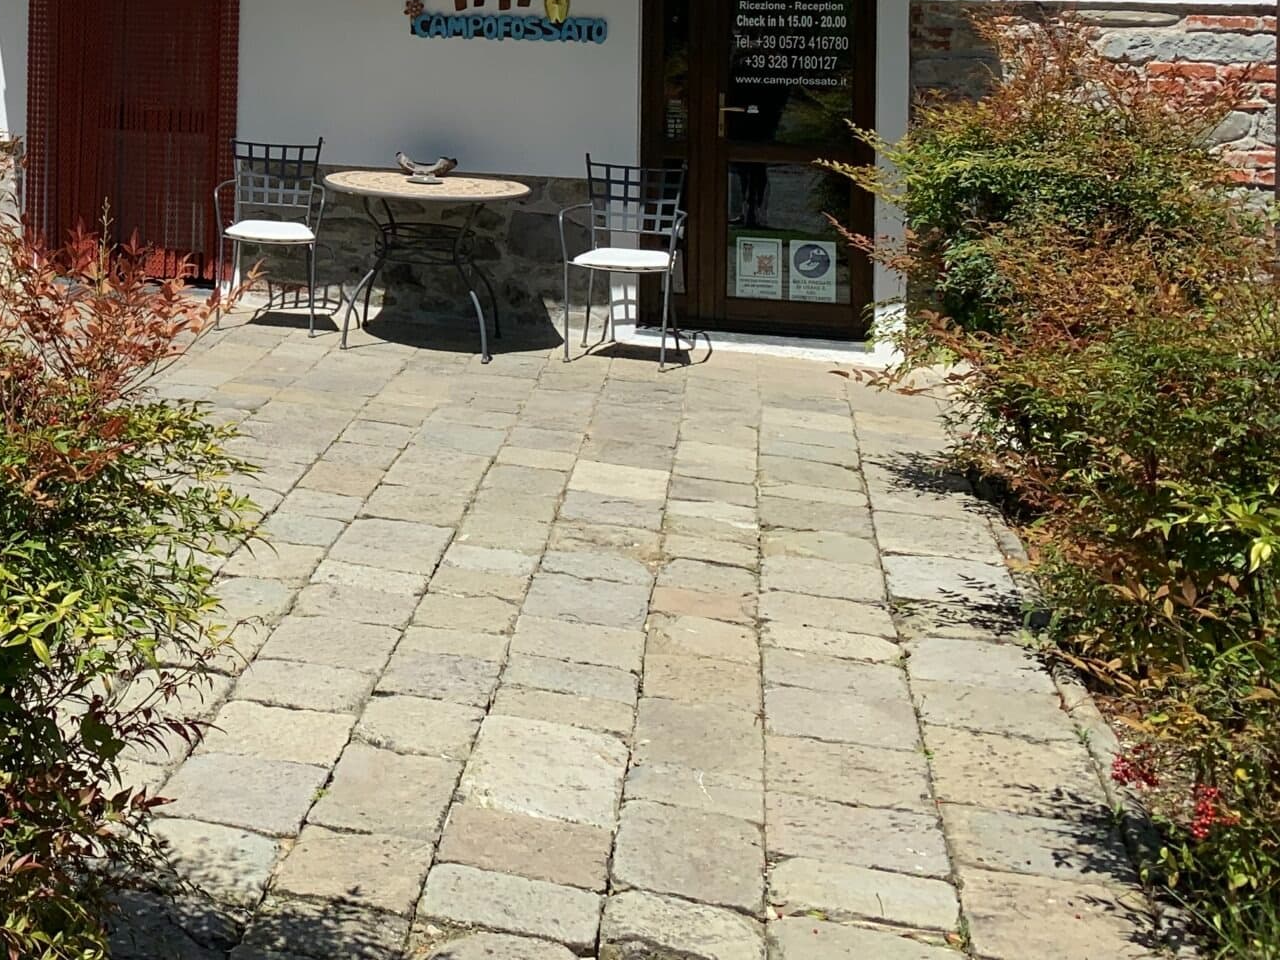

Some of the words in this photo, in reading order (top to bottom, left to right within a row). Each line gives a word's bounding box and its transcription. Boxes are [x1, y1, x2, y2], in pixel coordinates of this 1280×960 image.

[739, 1, 786, 10] Ricezione
[795, 1, 844, 12] Reception
[737, 15, 765, 27] Check
[768, 15, 776, 27] in
[779, 15, 784, 27] h
[787, 16, 812, 27] 15.00
[821, 16, 846, 27] 20.00
[413, 13, 608, 44] CAMPOFOSSATO
[734, 35, 752, 48] Tel.
[756, 35, 776, 48] +39
[779, 36, 805, 49] 0573
[808, 36, 849, 50] 416780
[745, 55, 765, 68] +39
[768, 55, 788, 69] 328
[791, 56, 838, 69] 7180127
[735, 76, 847, 86] www.campofossato.it
